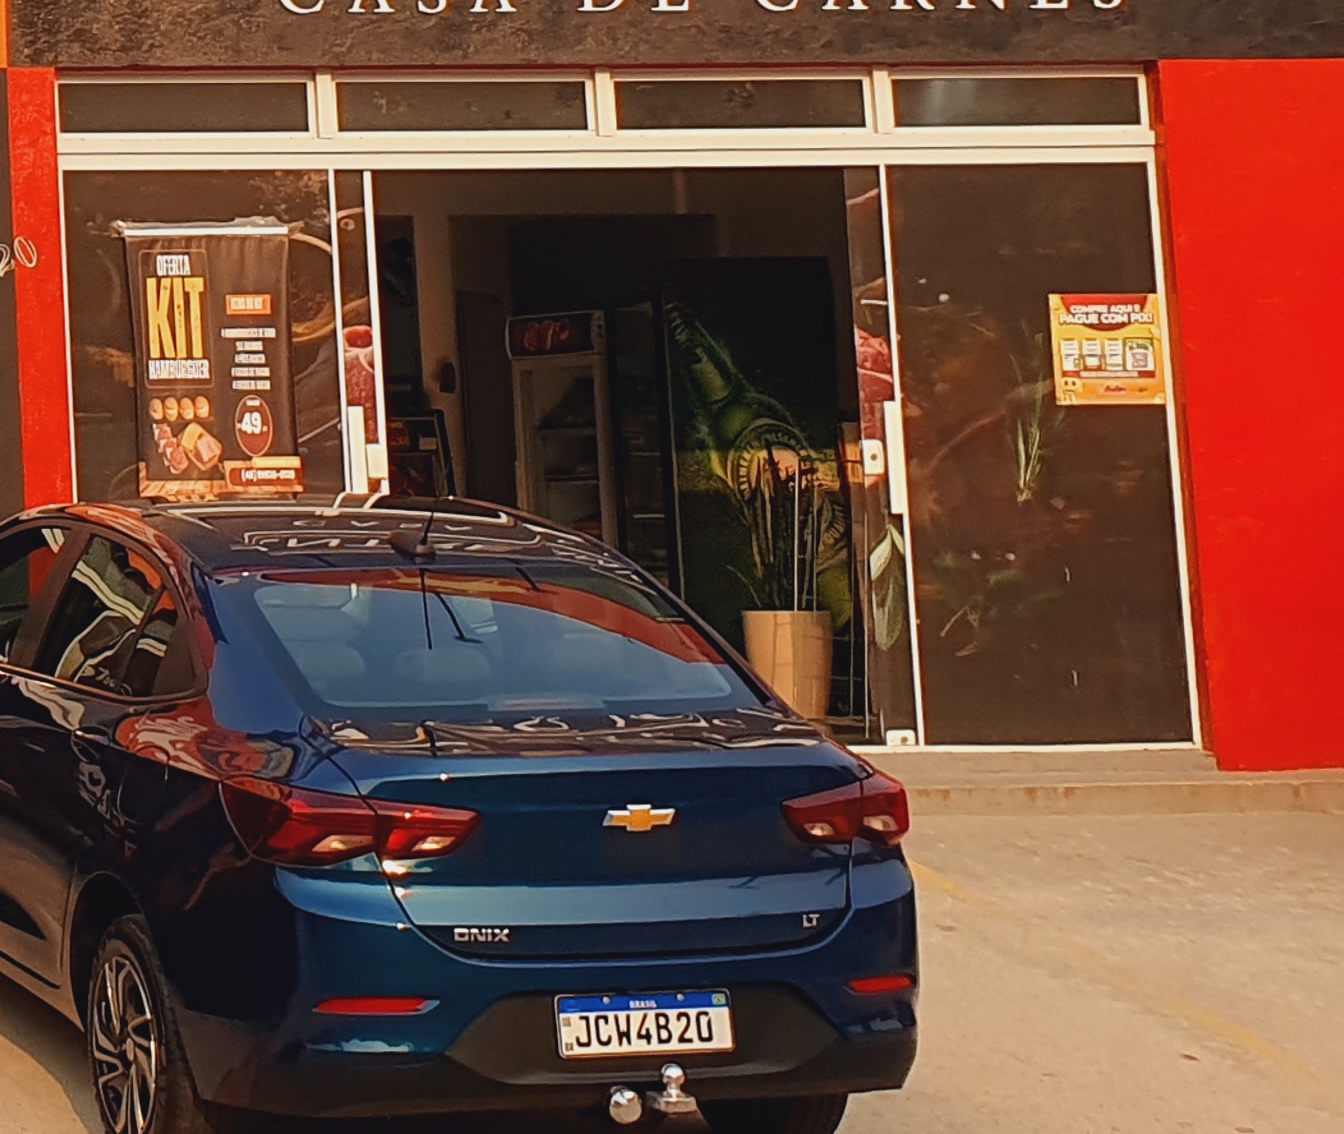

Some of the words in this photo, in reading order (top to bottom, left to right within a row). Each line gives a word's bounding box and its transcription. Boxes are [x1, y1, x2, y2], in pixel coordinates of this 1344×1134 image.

[145, 277, 205, 359] KIT
[1059, 313, 1099, 324] PAGUE
[1100, 313, 1129, 324] COM
[802, 913, 820, 929] LT
[453, 927, 510, 942] ONIX
[575, 1010, 713, 1048] JCW4B20
